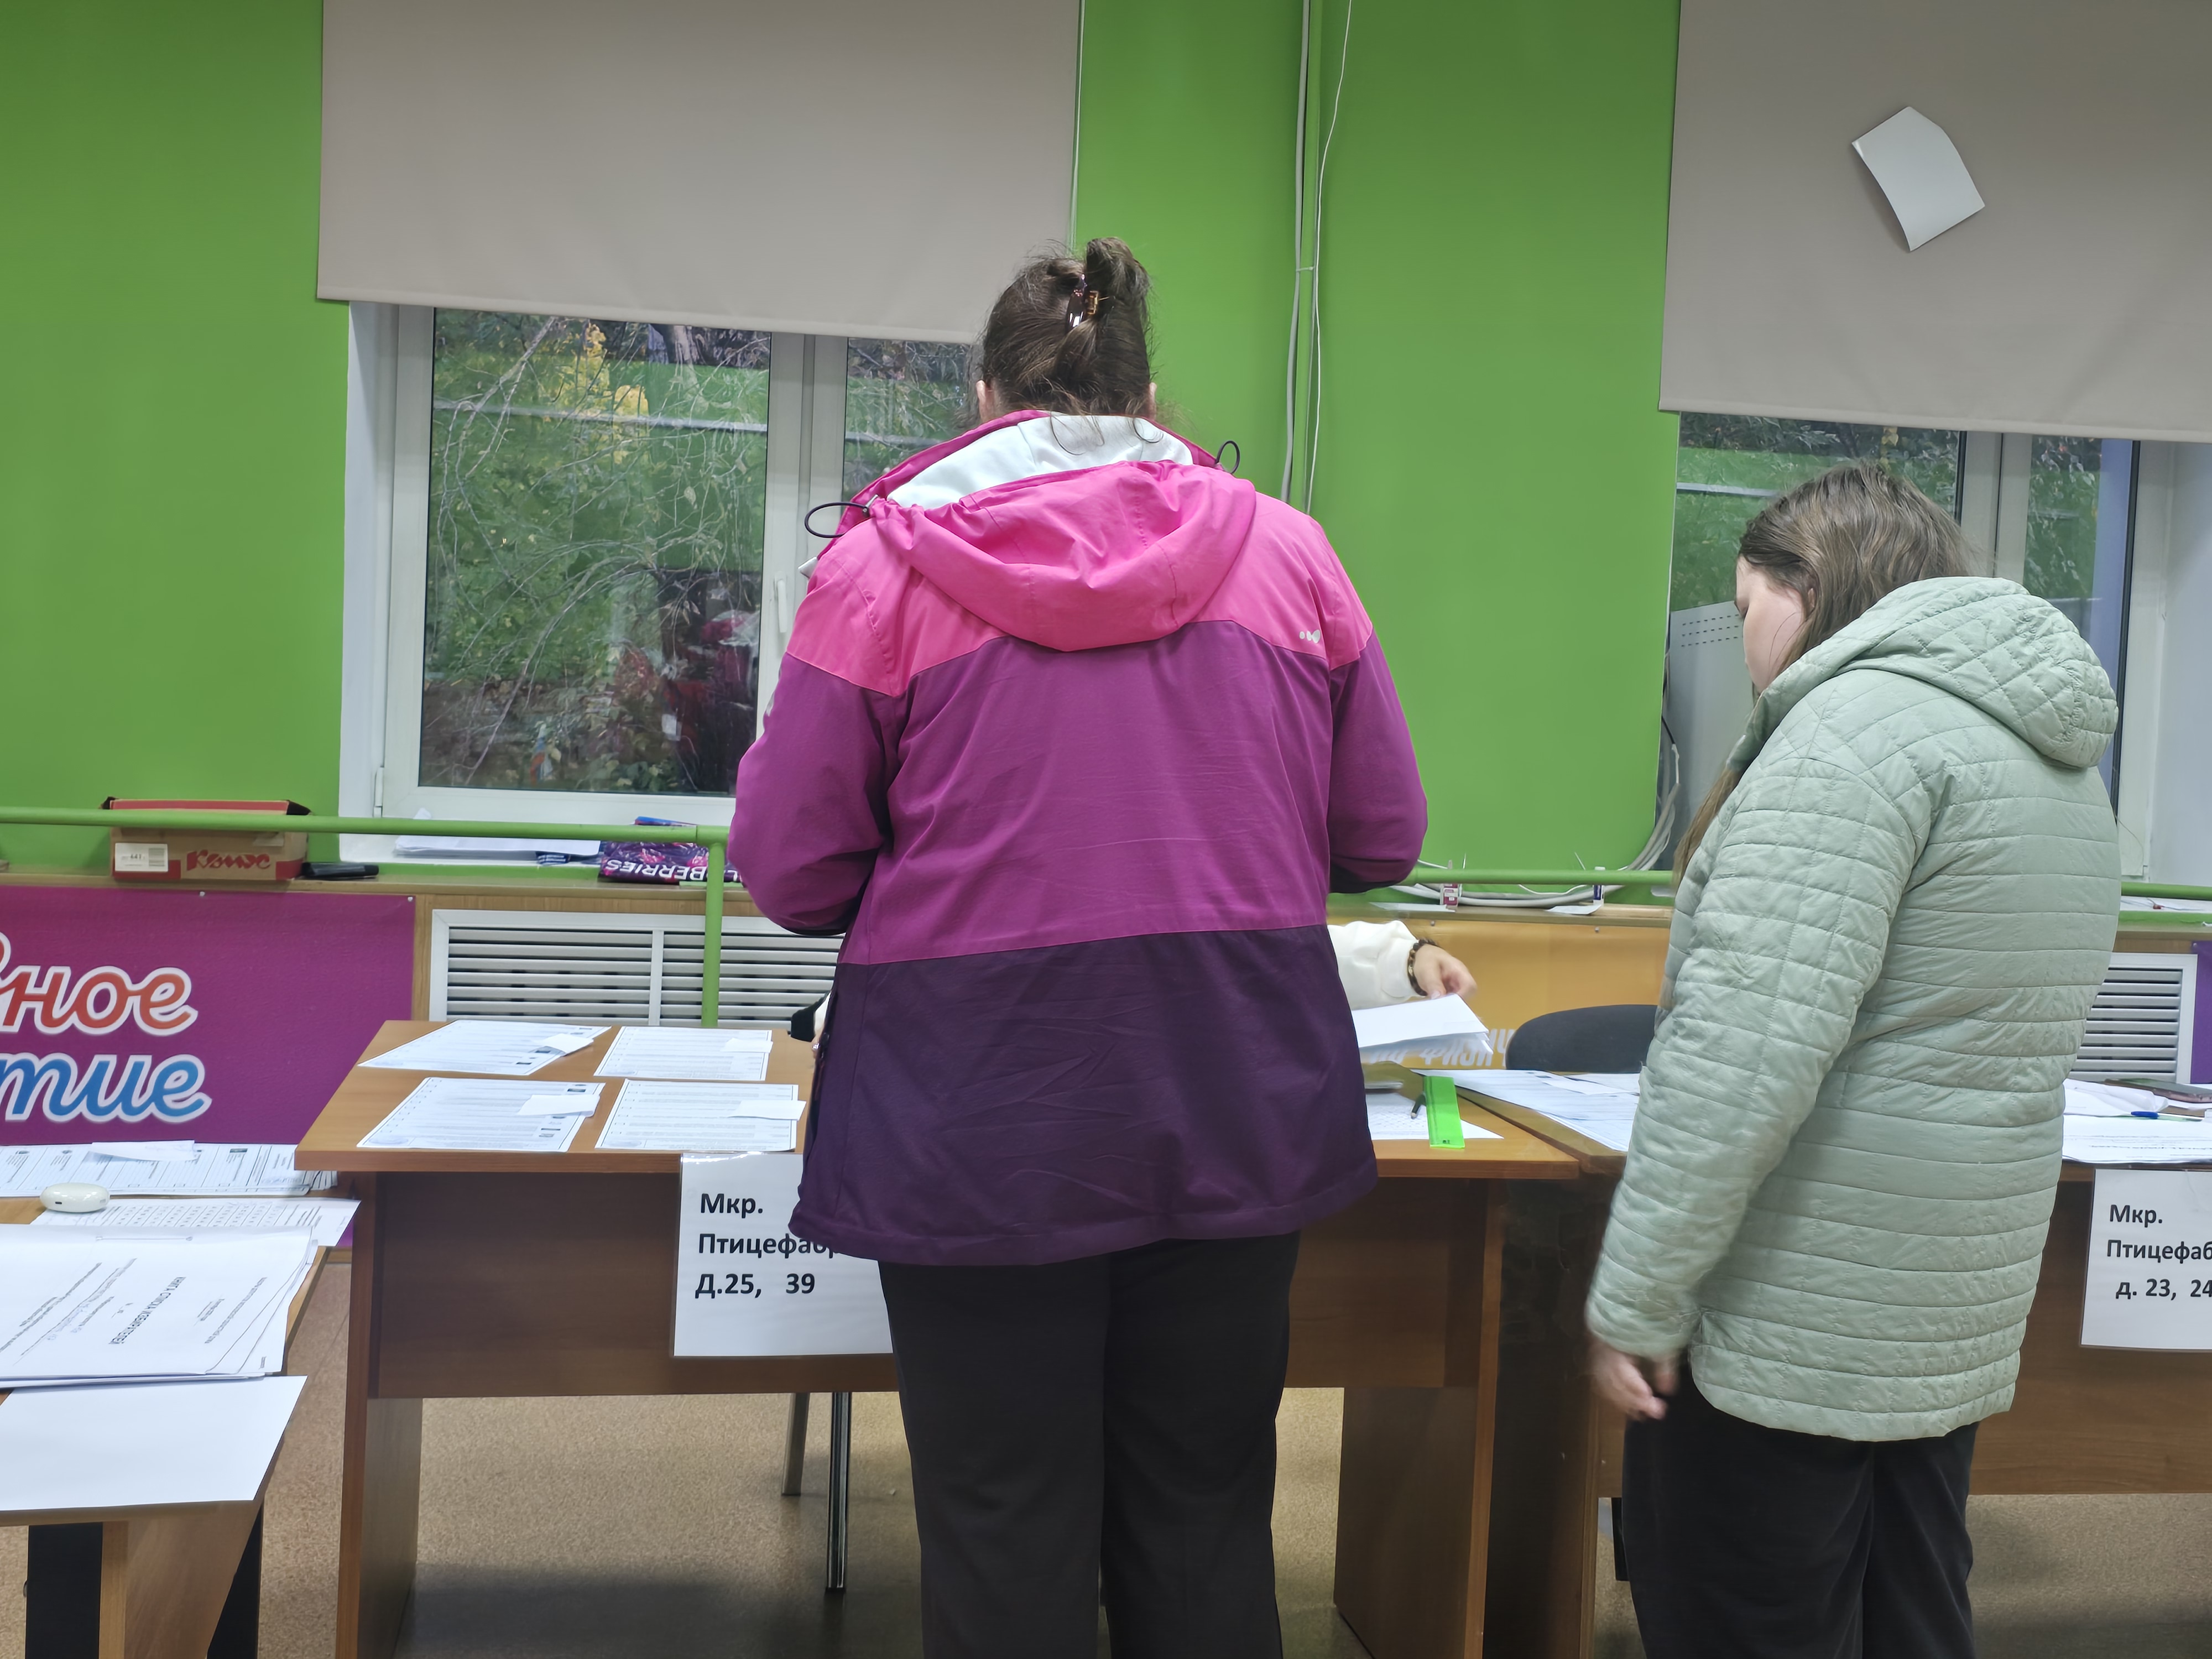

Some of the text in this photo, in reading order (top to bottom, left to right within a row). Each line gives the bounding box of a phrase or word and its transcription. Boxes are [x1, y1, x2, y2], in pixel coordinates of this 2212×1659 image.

[0, 932, 198, 1036] ное
[701, 1193, 763, 1218] Мкр.
[2110, 1204, 2163, 1228] Мкр.
[695, 1274, 815, 1298] Д.25, 39
[2115, 1278, 2212, 1301] д. 23, 24
